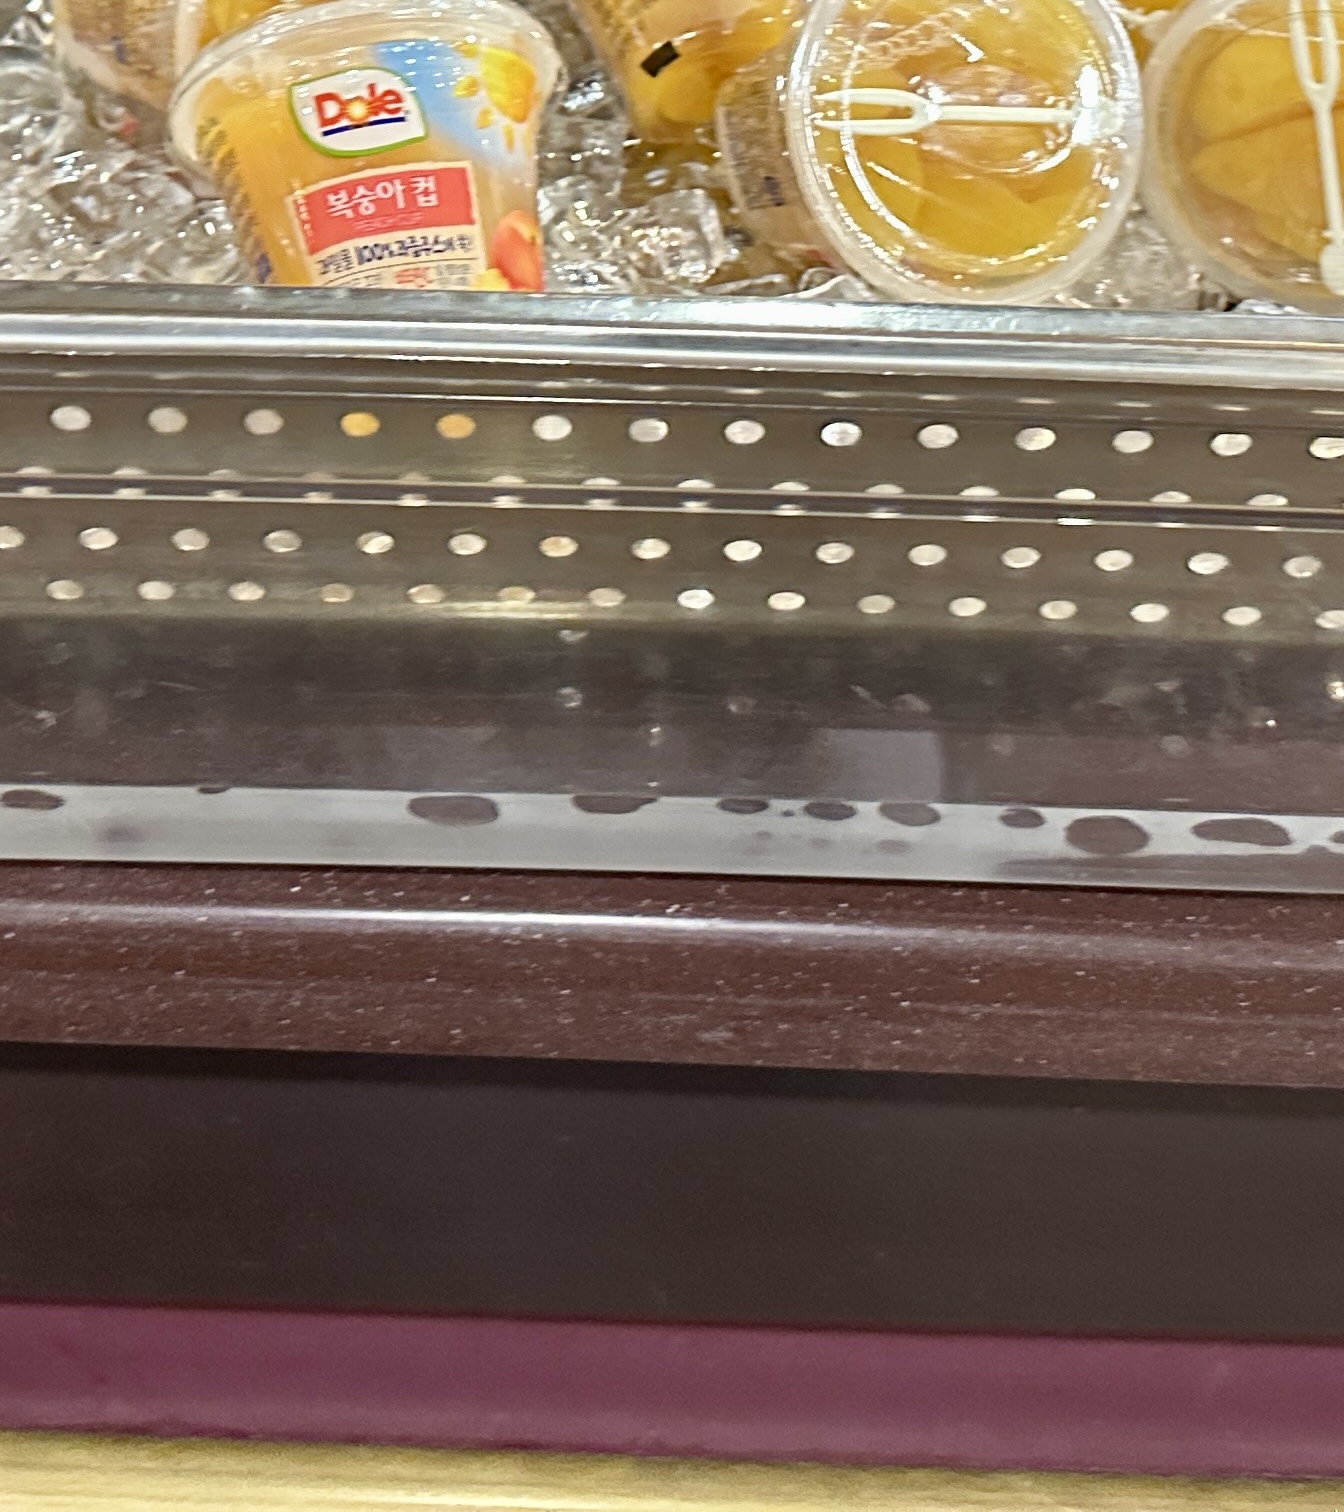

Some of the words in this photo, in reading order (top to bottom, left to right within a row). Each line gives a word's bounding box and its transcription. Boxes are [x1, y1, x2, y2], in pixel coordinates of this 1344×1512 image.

[314, 83, 403, 128] Dole
[326, 179, 406, 219] 복숭아
[409, 175, 439, 208] 컵
